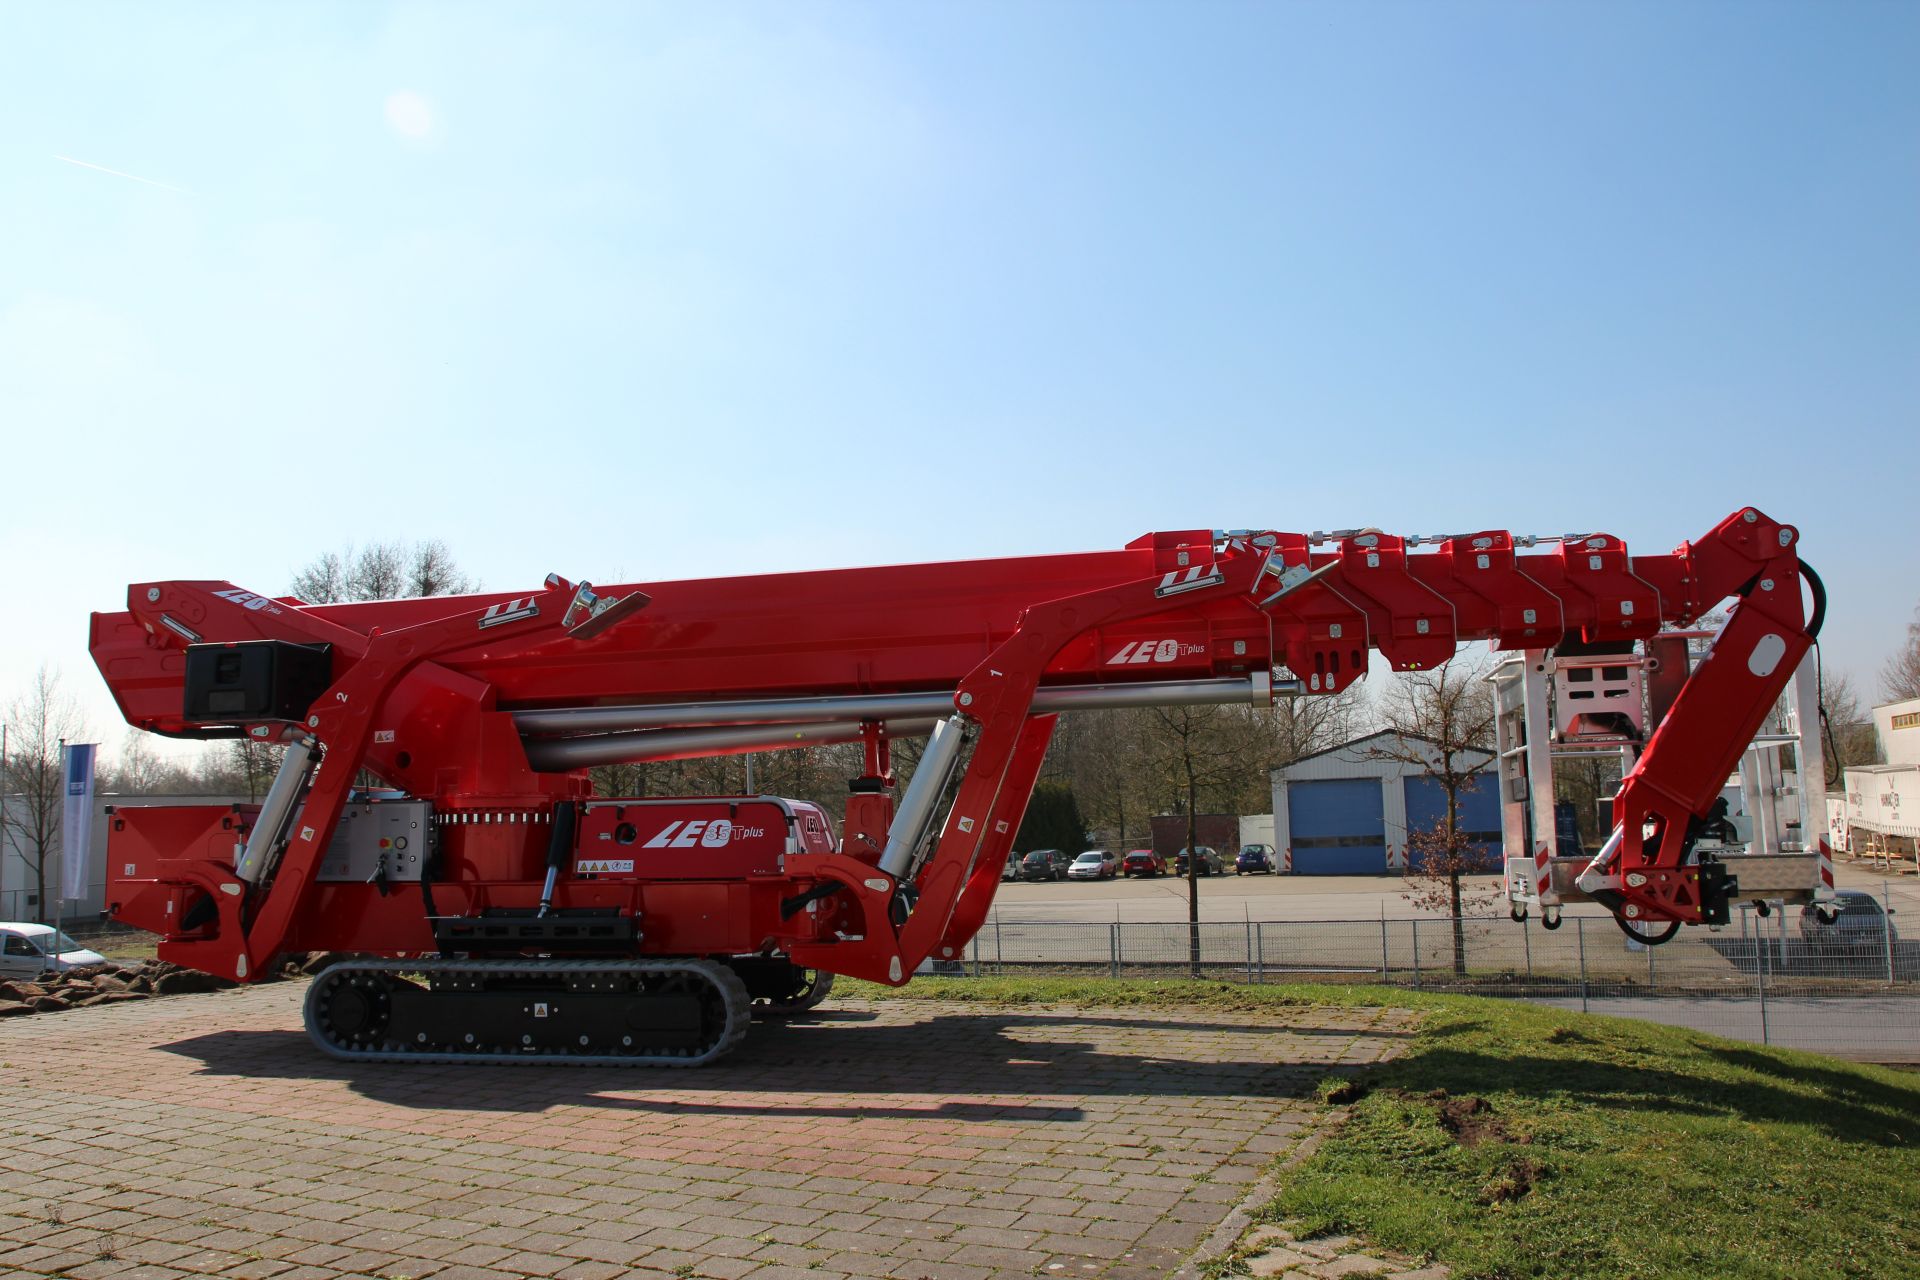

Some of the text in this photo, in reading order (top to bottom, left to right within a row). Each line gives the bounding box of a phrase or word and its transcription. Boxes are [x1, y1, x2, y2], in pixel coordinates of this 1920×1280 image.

[210, 589, 269, 611] LEO
[1105, 639, 1178, 665] LEO
[336, 692, 348, 703] 2
[641, 819, 732, 849] LEO
[806, 816, 820, 833] LEO
